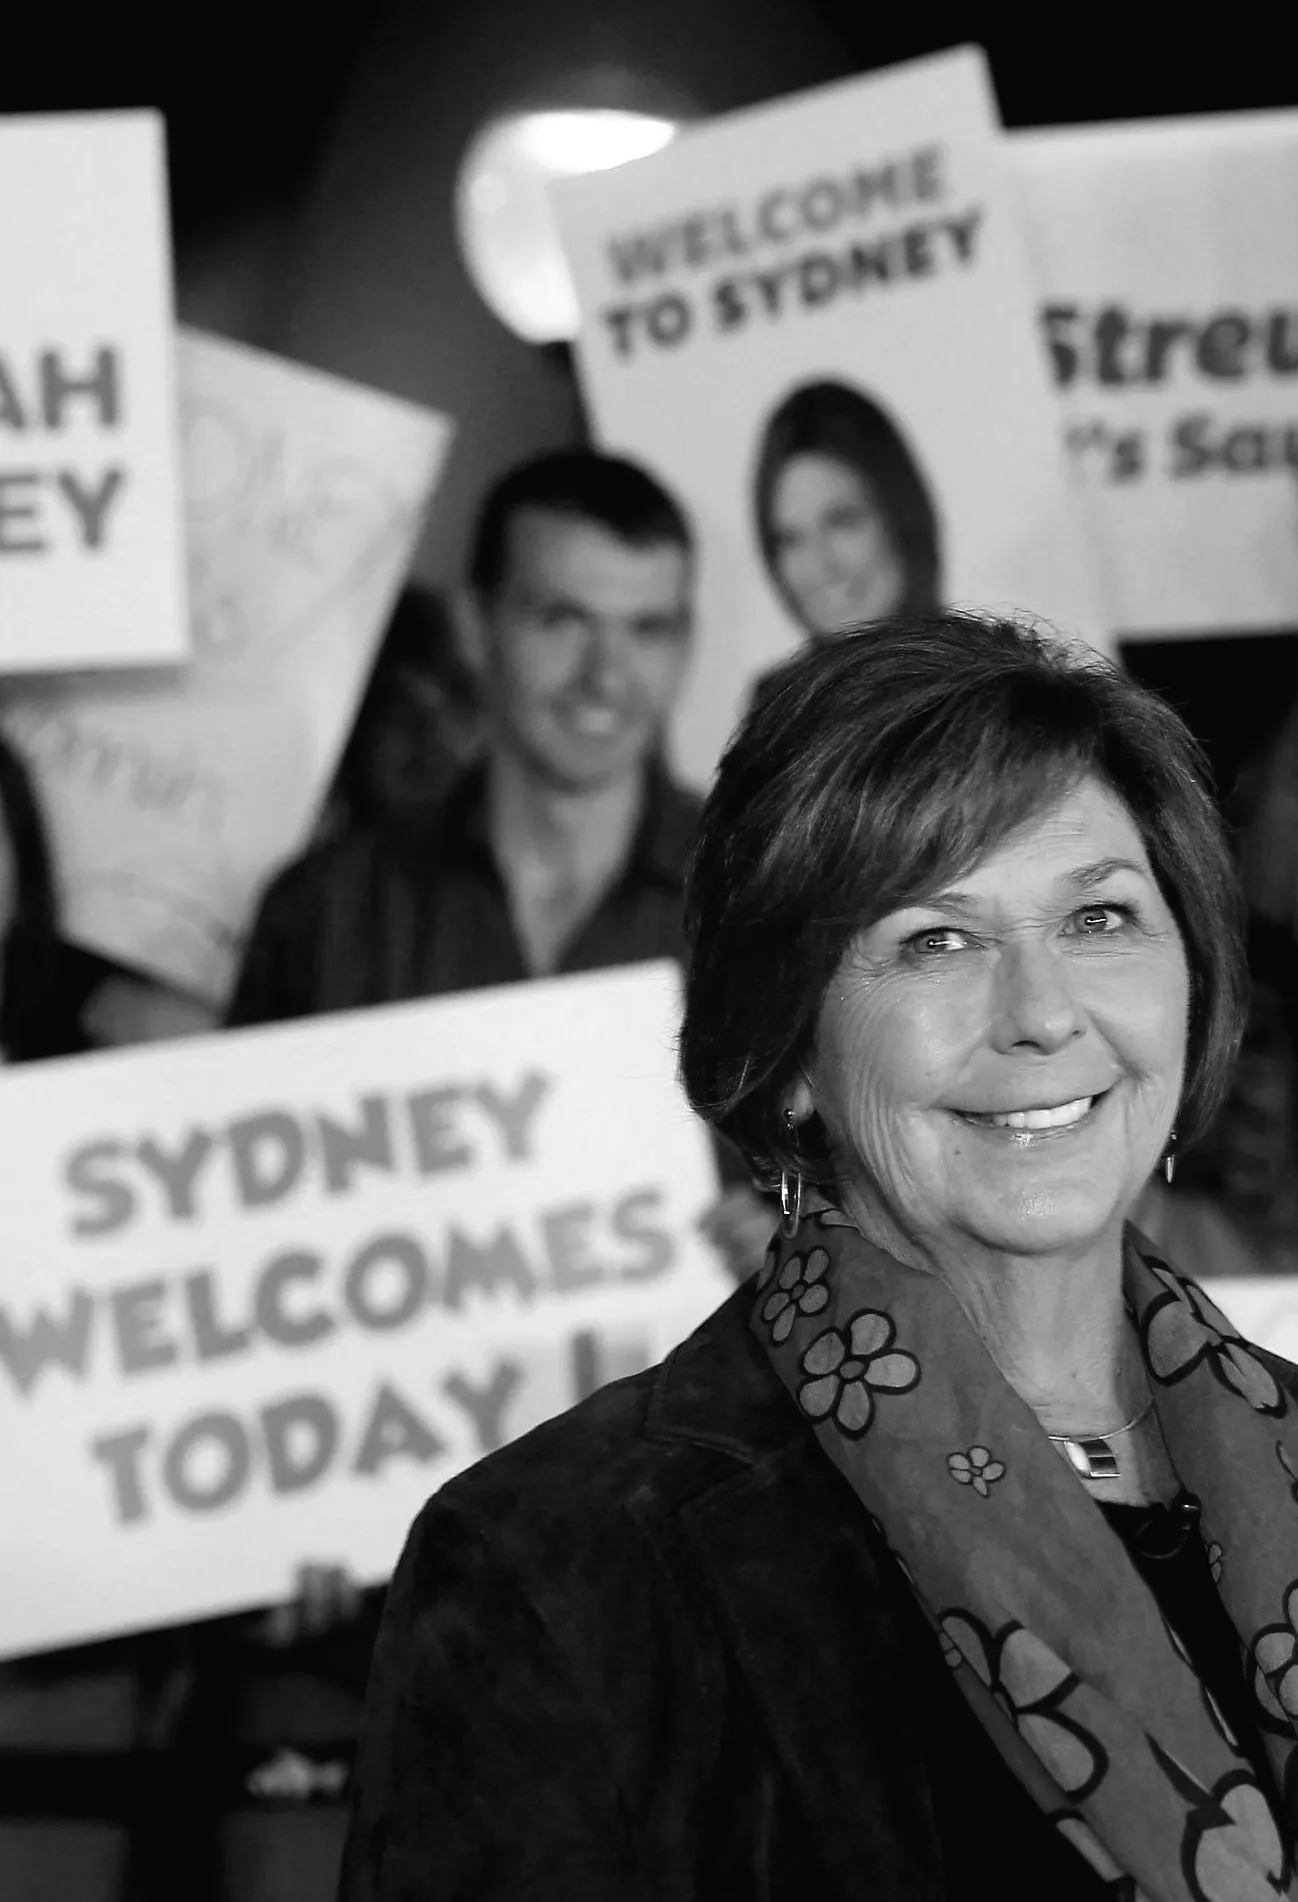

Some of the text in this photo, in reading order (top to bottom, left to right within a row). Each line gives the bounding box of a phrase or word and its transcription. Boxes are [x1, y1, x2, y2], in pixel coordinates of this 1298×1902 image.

[605, 143, 948, 286] WELCOME
[606, 206, 984, 360] TO SYDNEY
[64, 1073, 550, 1238] SYDNEY
[0, 1190, 675, 1398] WELCOMES
[95, 1360, 522, 1526] TODAY
